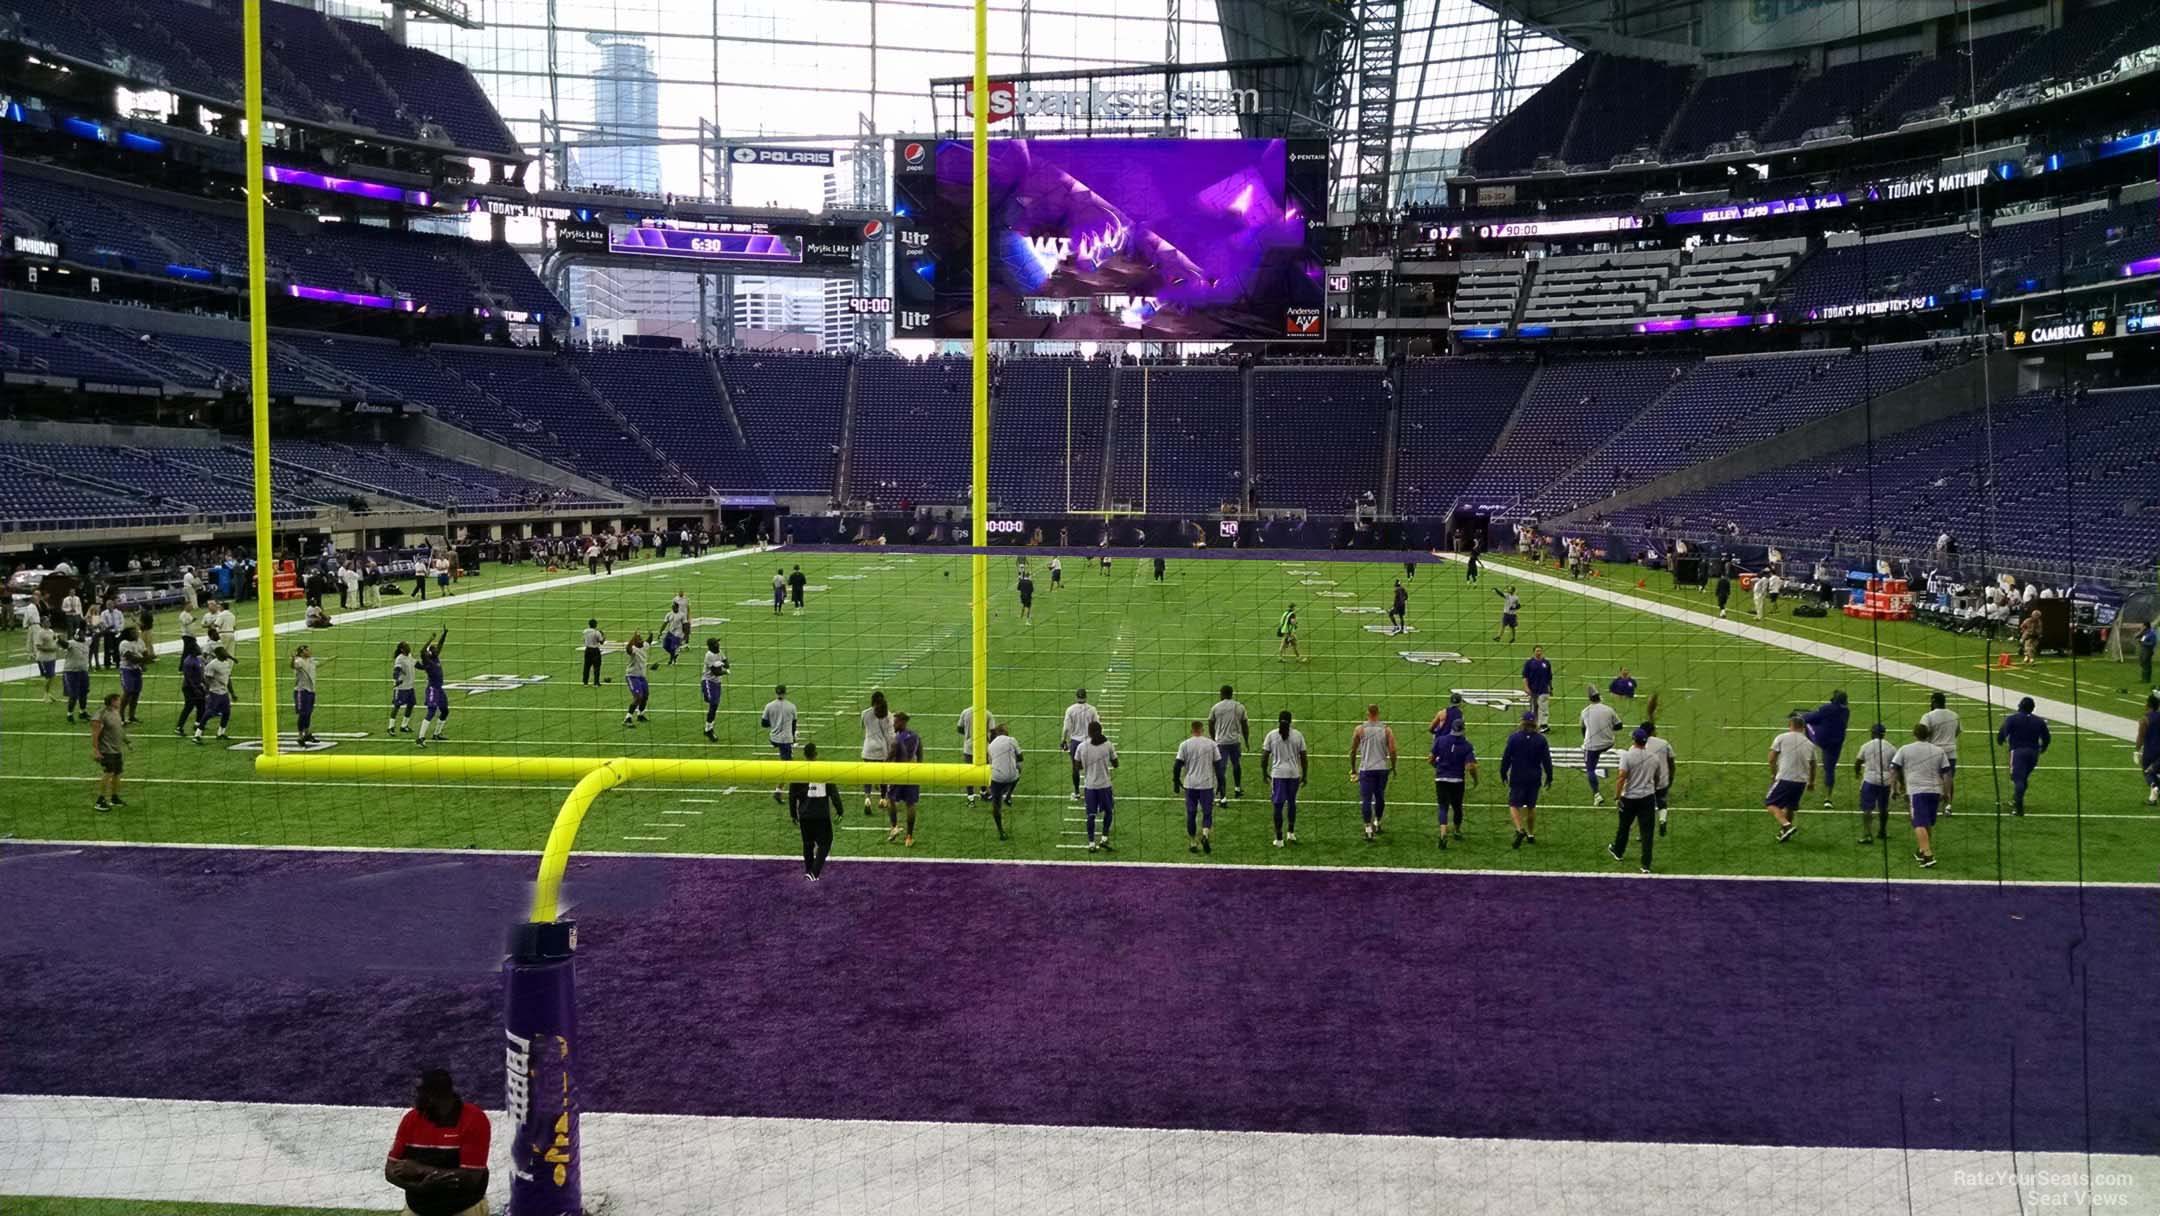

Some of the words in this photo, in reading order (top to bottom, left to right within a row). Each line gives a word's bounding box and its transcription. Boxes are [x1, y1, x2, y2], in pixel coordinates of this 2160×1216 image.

[760, 151, 830, 164] POLARIS
[1887, 178, 1935, 200] TODAY'S
[487, 201, 524, 217] TODAY'S
[526, 206, 571, 221] MATCHUP
[1702, 211, 1738, 223] KELLEY
[1506, 225, 1538, 236] 90:00
[691, 238, 722, 252] 6:30
[901, 231, 930, 246] Lite
[1330, 277, 1348, 291] 40
[850, 298, 890, 313] 90:00
[1287, 306, 1320, 315] Andersen
[1823, 305, 1854, 319] TODAY'S
[901, 311, 930, 330] Lite
[2031, 323, 2085, 342] CAMBRIA
[1222, 523, 1237, 535] 40
